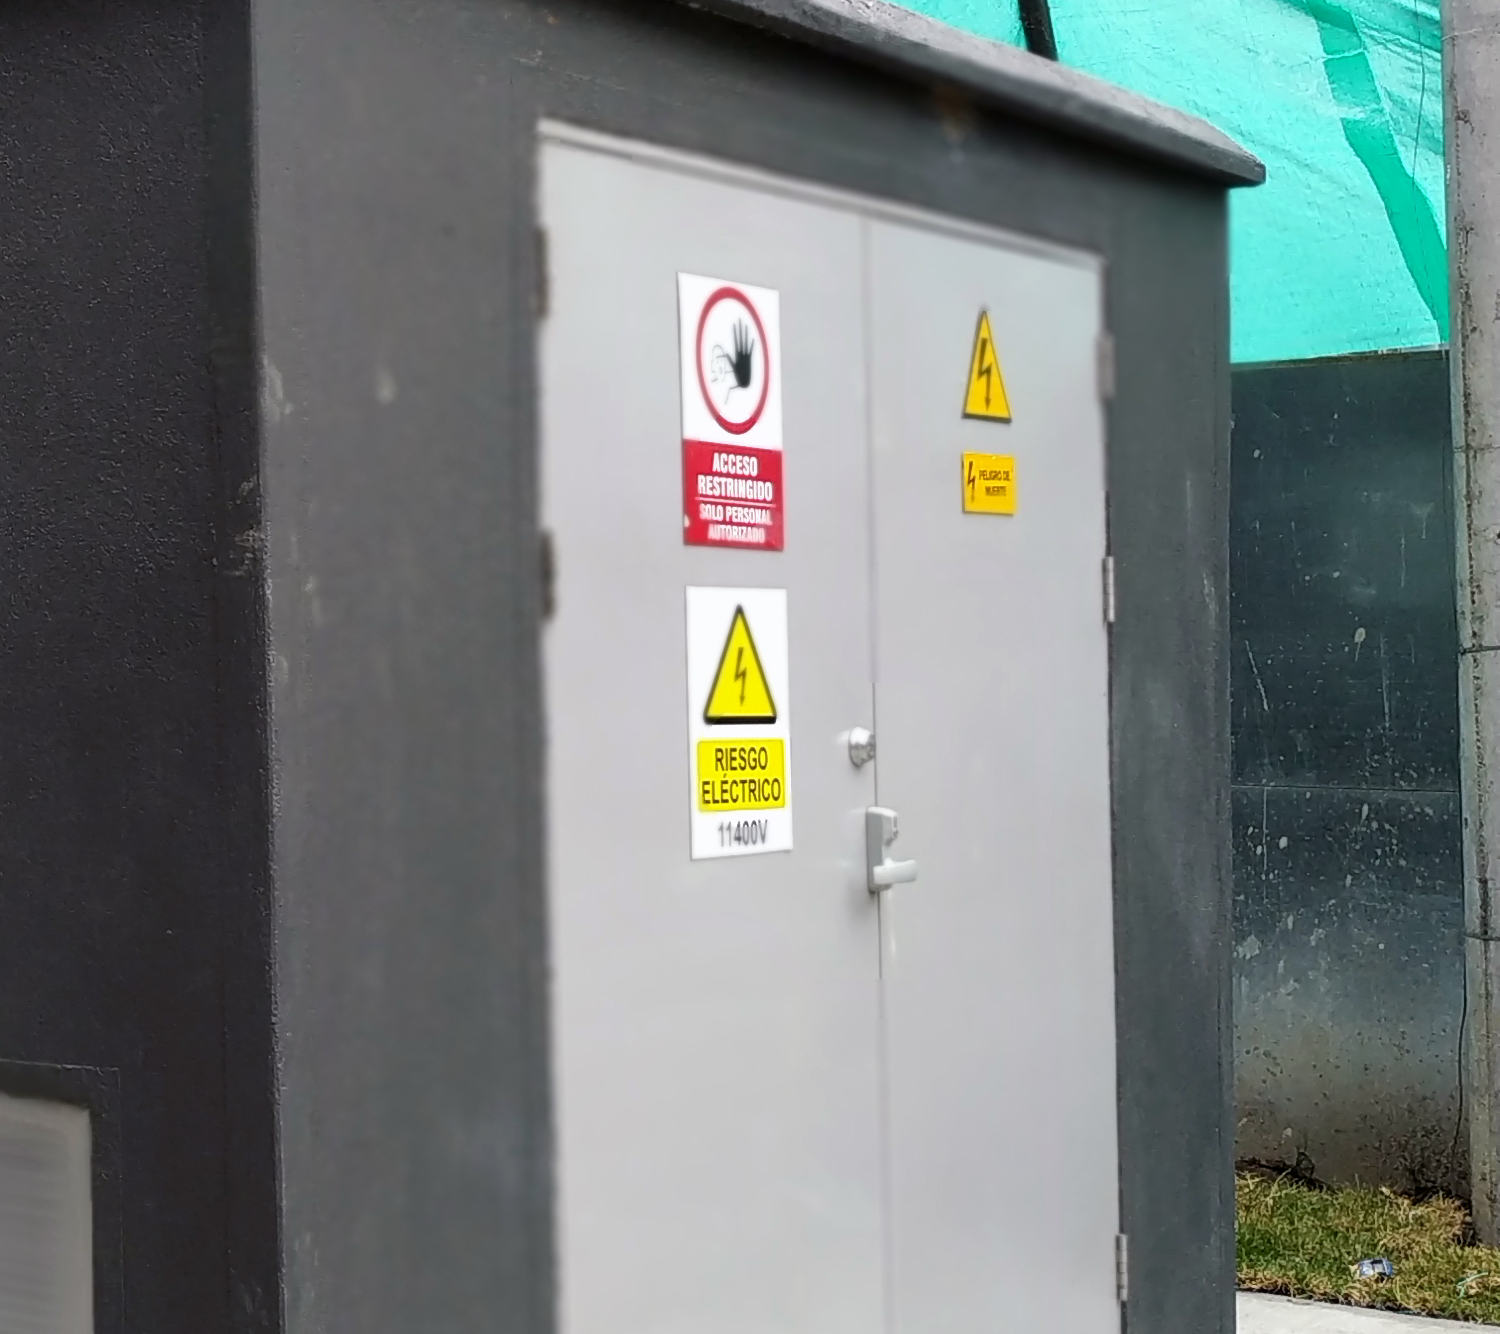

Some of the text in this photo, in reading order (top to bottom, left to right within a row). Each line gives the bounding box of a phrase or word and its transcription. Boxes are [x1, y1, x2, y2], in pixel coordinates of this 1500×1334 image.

[712, 452, 758, 477] ACCESO
[697, 474, 773, 502] RESTRINGIDO
[699, 503, 773, 526] SOLO PERSONAL
[707, 523, 766, 544] AUTORIZADO
[714, 746, 769, 772] RIESGO
[701, 772, 782, 805] ELÉCTRICO
[717, 818, 768, 848] 11400V
